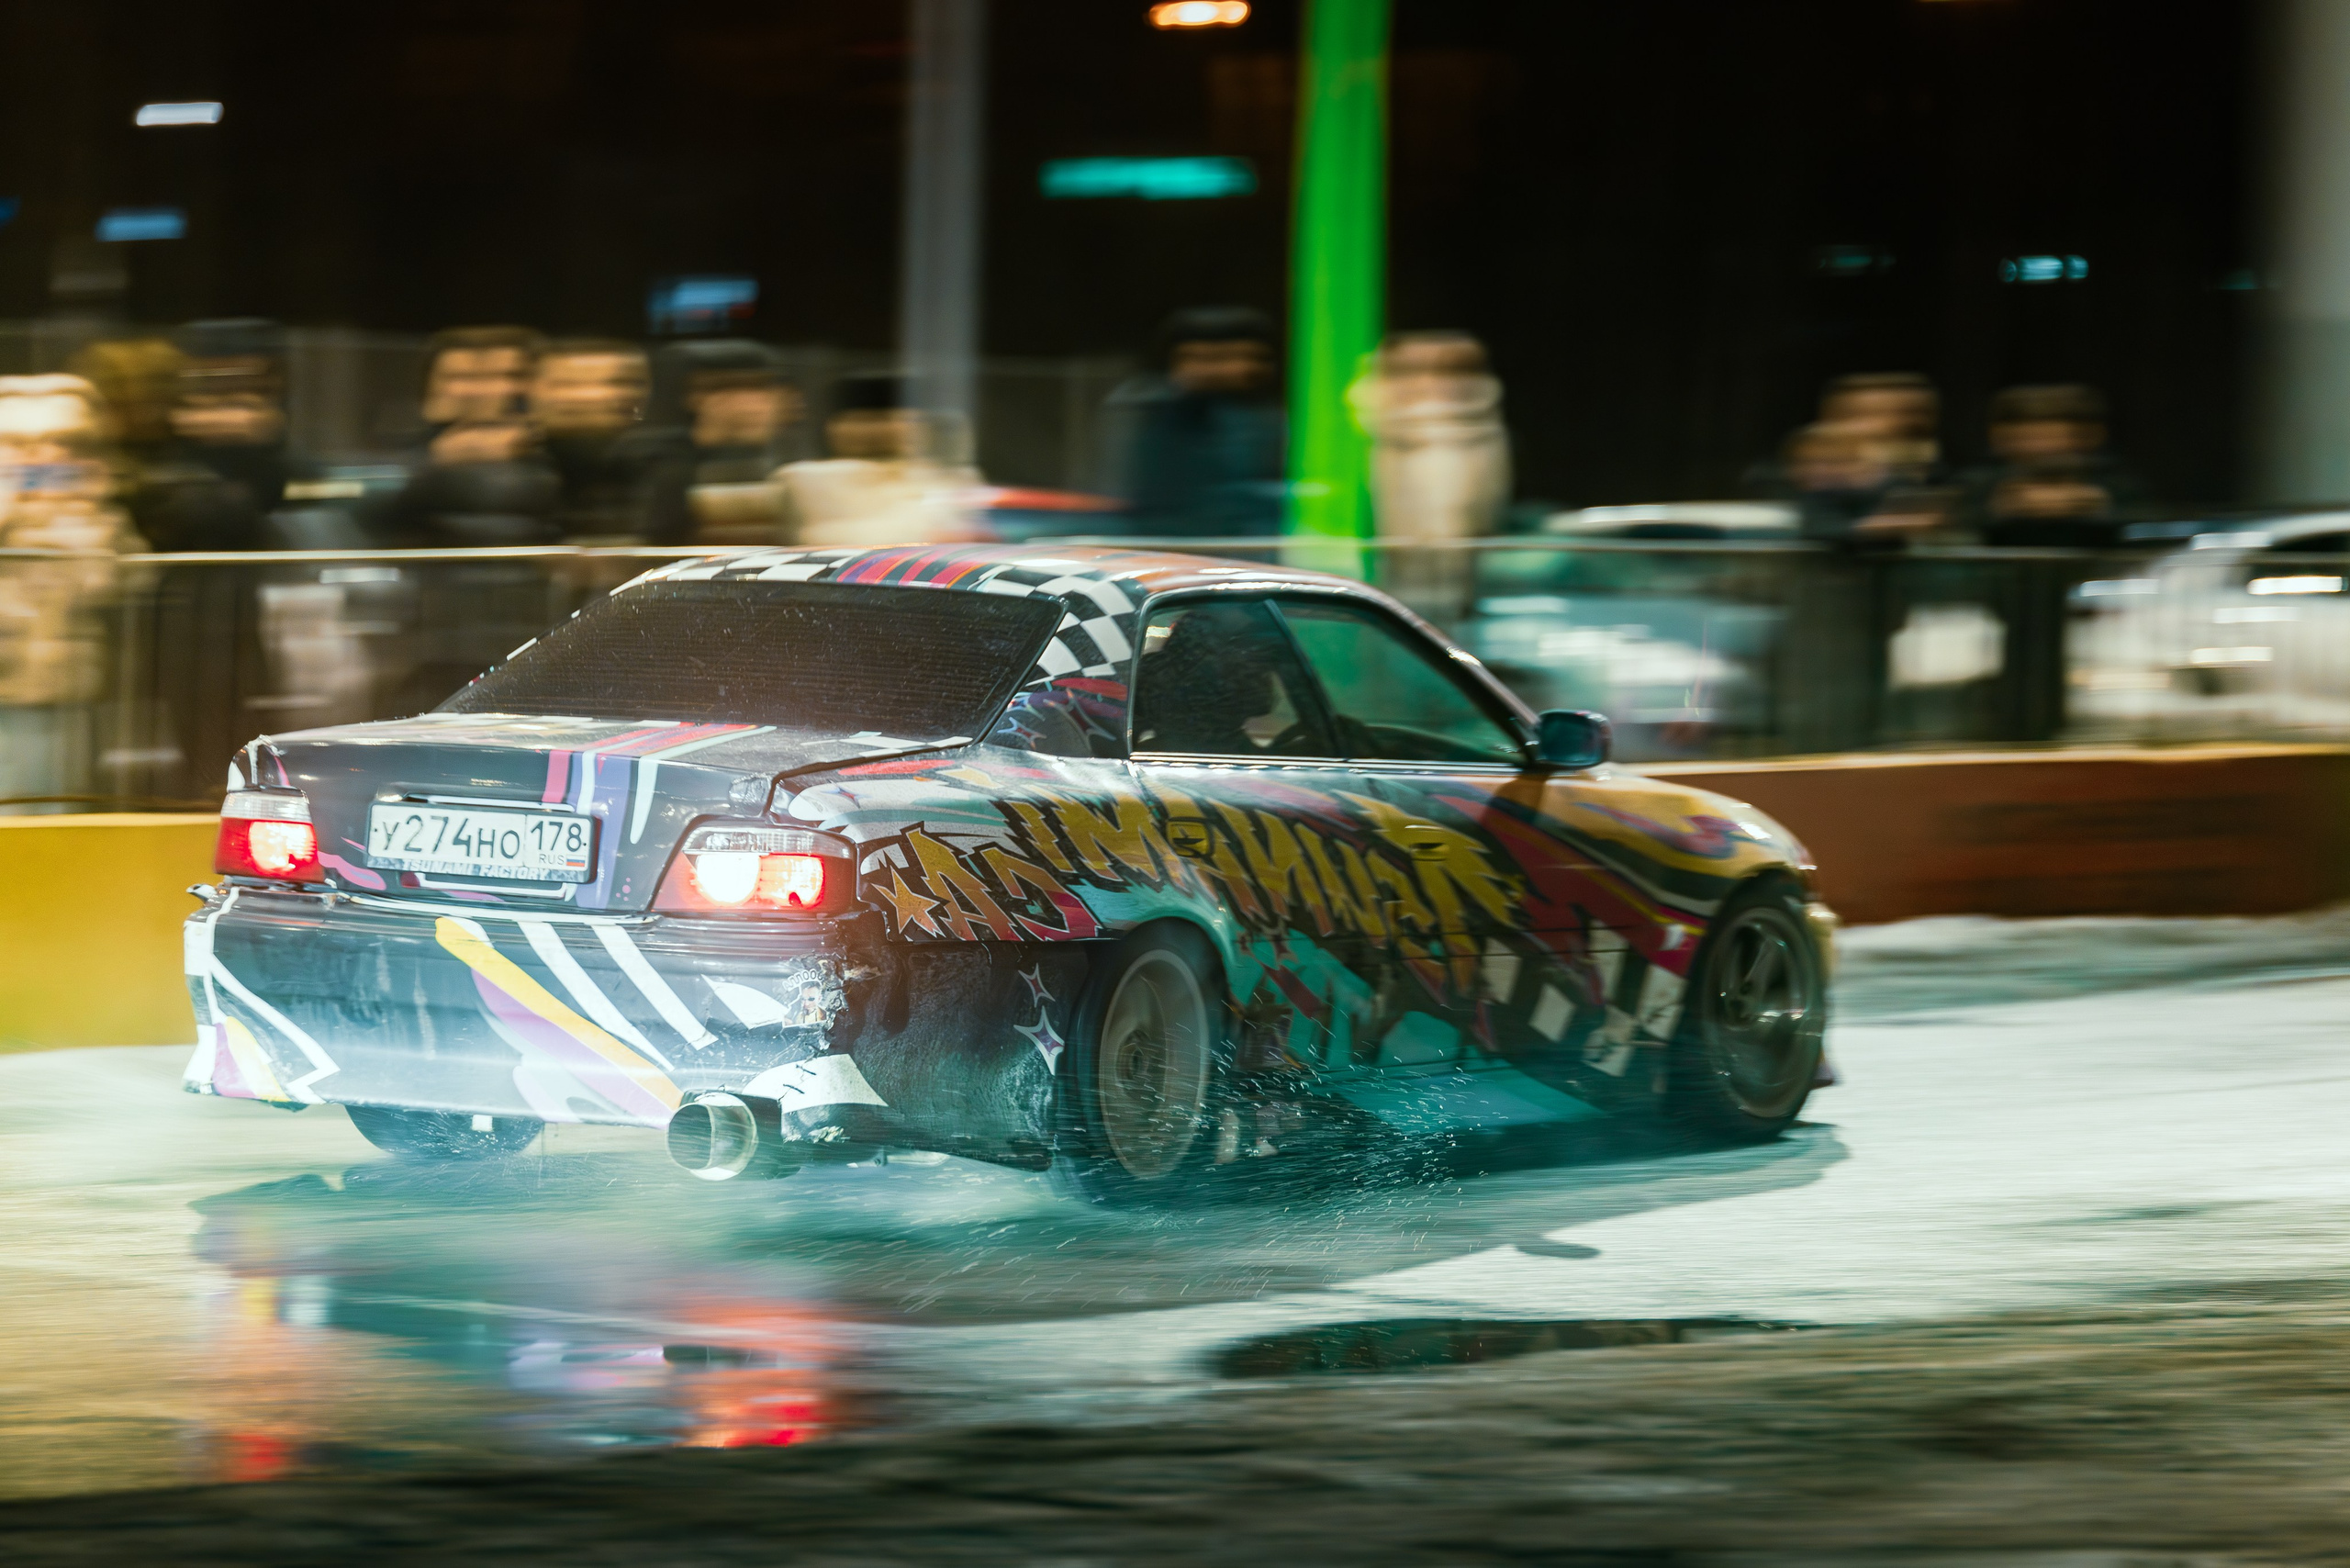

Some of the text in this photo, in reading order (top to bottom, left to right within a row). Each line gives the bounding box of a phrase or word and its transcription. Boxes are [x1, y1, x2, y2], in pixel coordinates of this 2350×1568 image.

[530, 820, 582, 852] 178
[402, 858, 551, 880] TSUNAMI FACTORY
[539, 853, 565, 865] RUS
